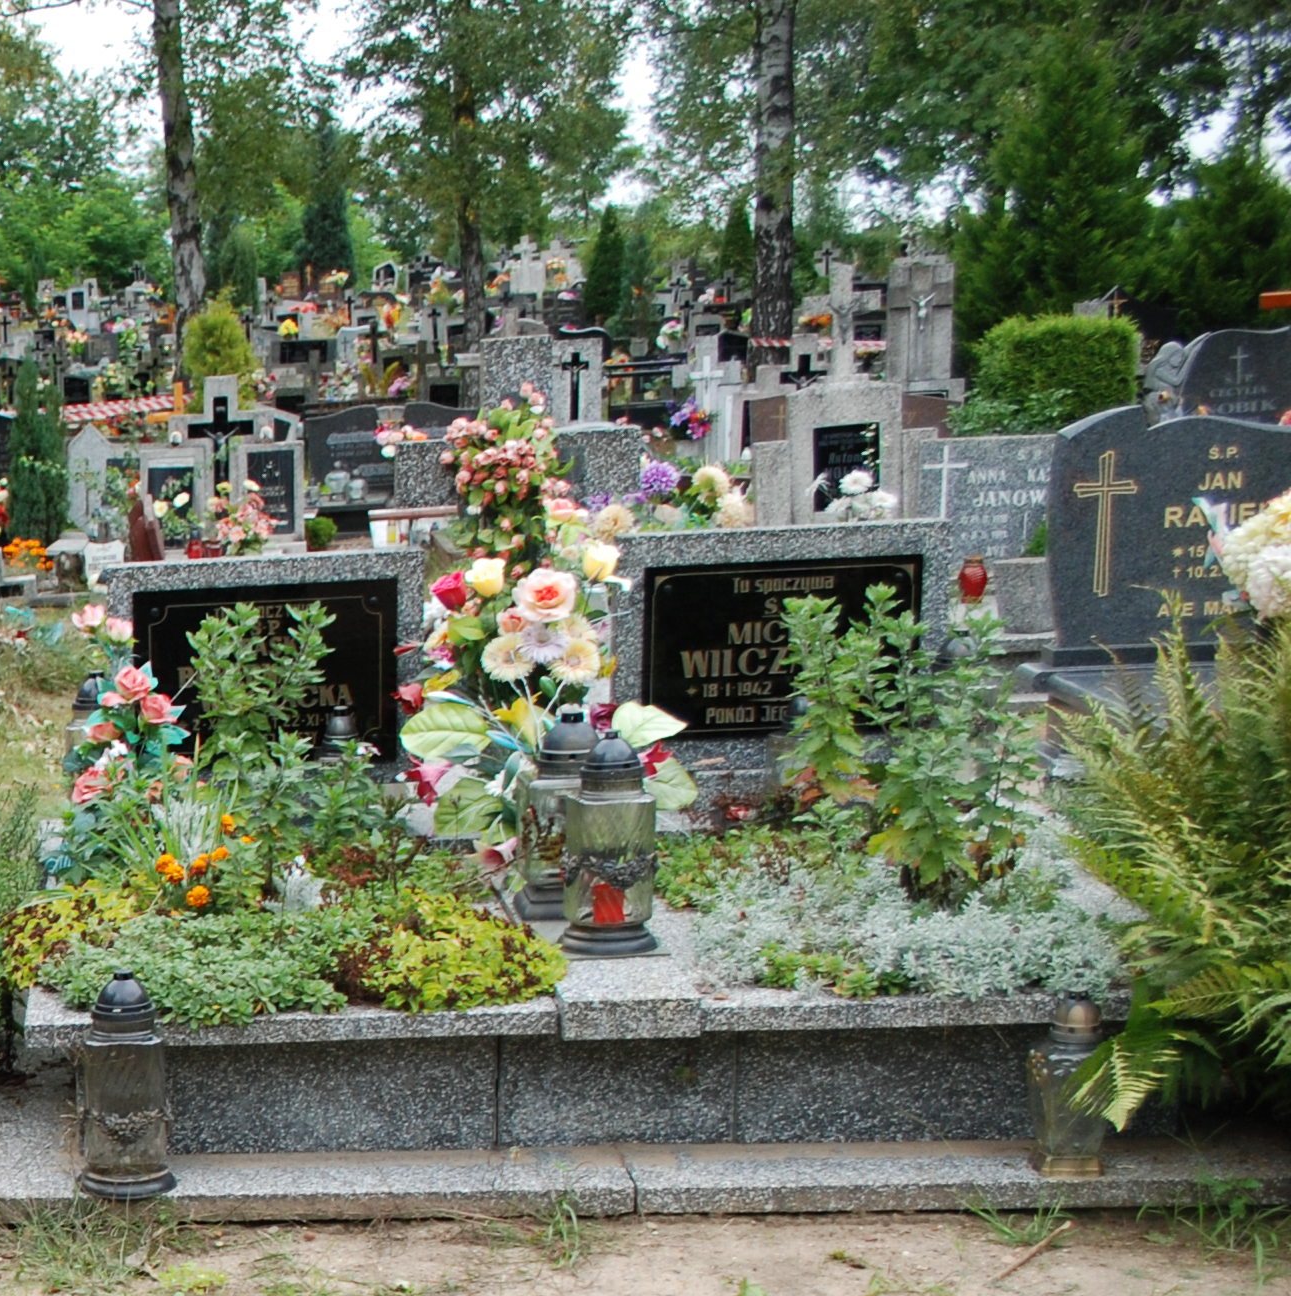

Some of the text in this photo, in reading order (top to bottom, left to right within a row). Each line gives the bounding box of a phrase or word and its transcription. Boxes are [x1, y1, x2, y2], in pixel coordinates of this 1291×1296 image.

[1198, 471, 1243, 491] JAN
[733, 575, 835, 595] Tu spoczywa
[705, 705, 790, 724] POKÓJ JEG
